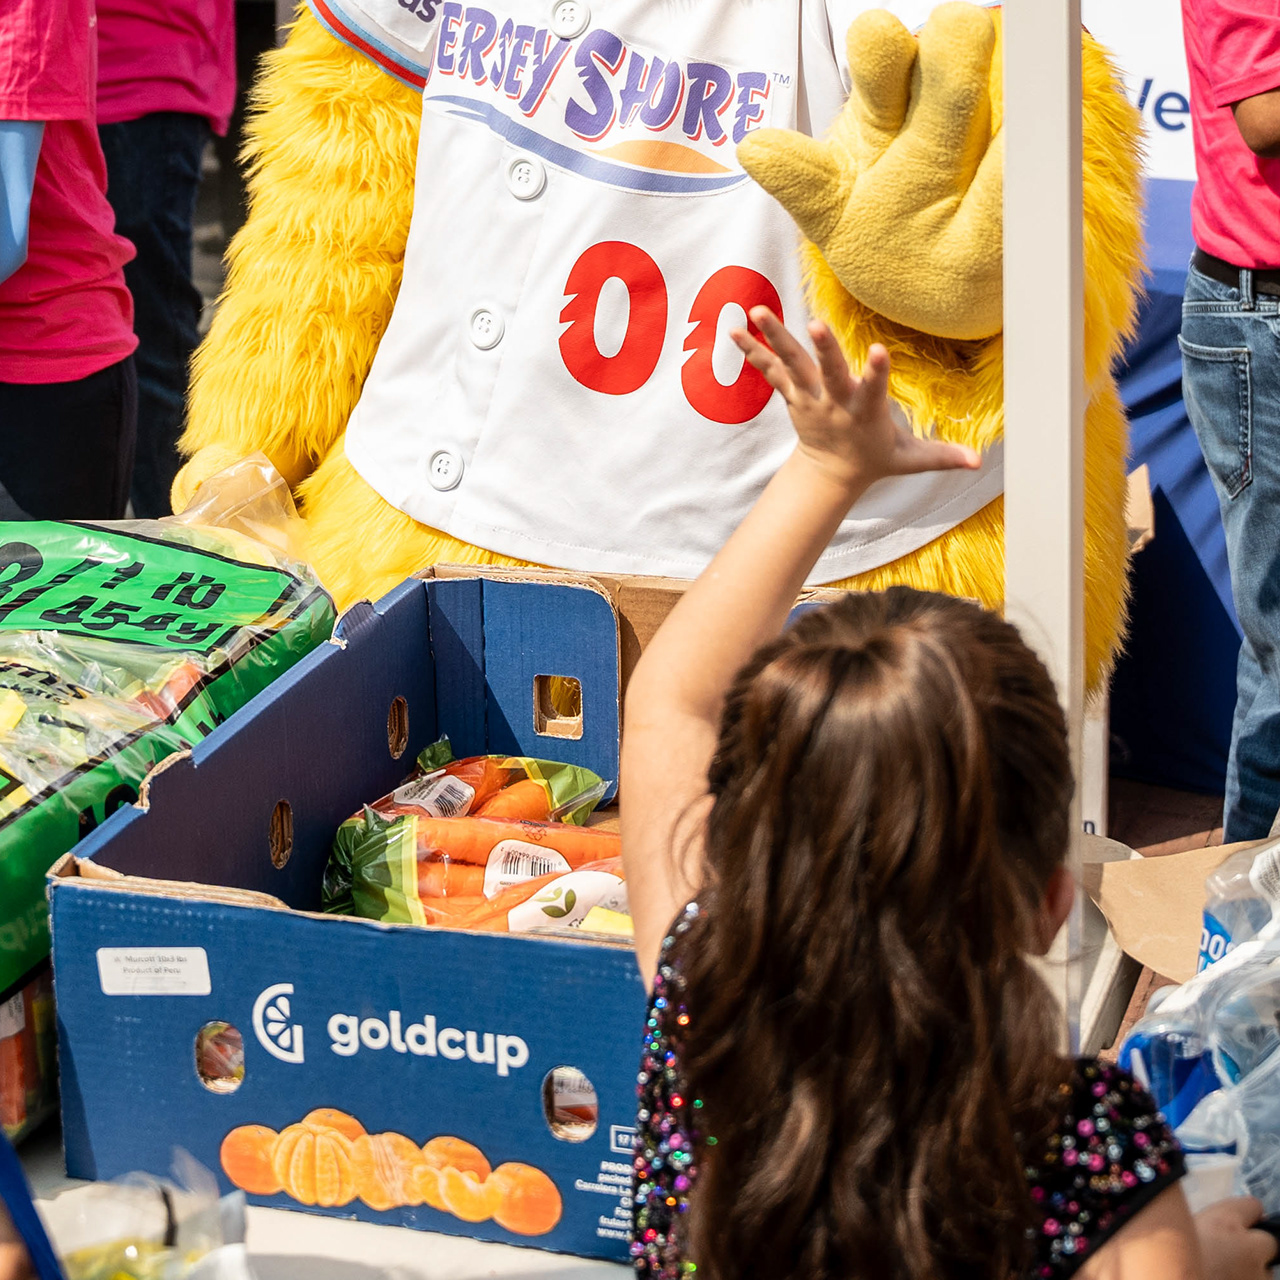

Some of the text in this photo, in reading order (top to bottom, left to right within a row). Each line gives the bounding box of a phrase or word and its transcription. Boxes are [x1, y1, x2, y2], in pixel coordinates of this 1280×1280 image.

[430, 1, 573, 118] ERSEY
[565, 28, 772, 148] SHORE
[558, 239, 785, 425] 00
[123, 966, 152, 974] Product
[326, 1009, 530, 1077] goldcup
